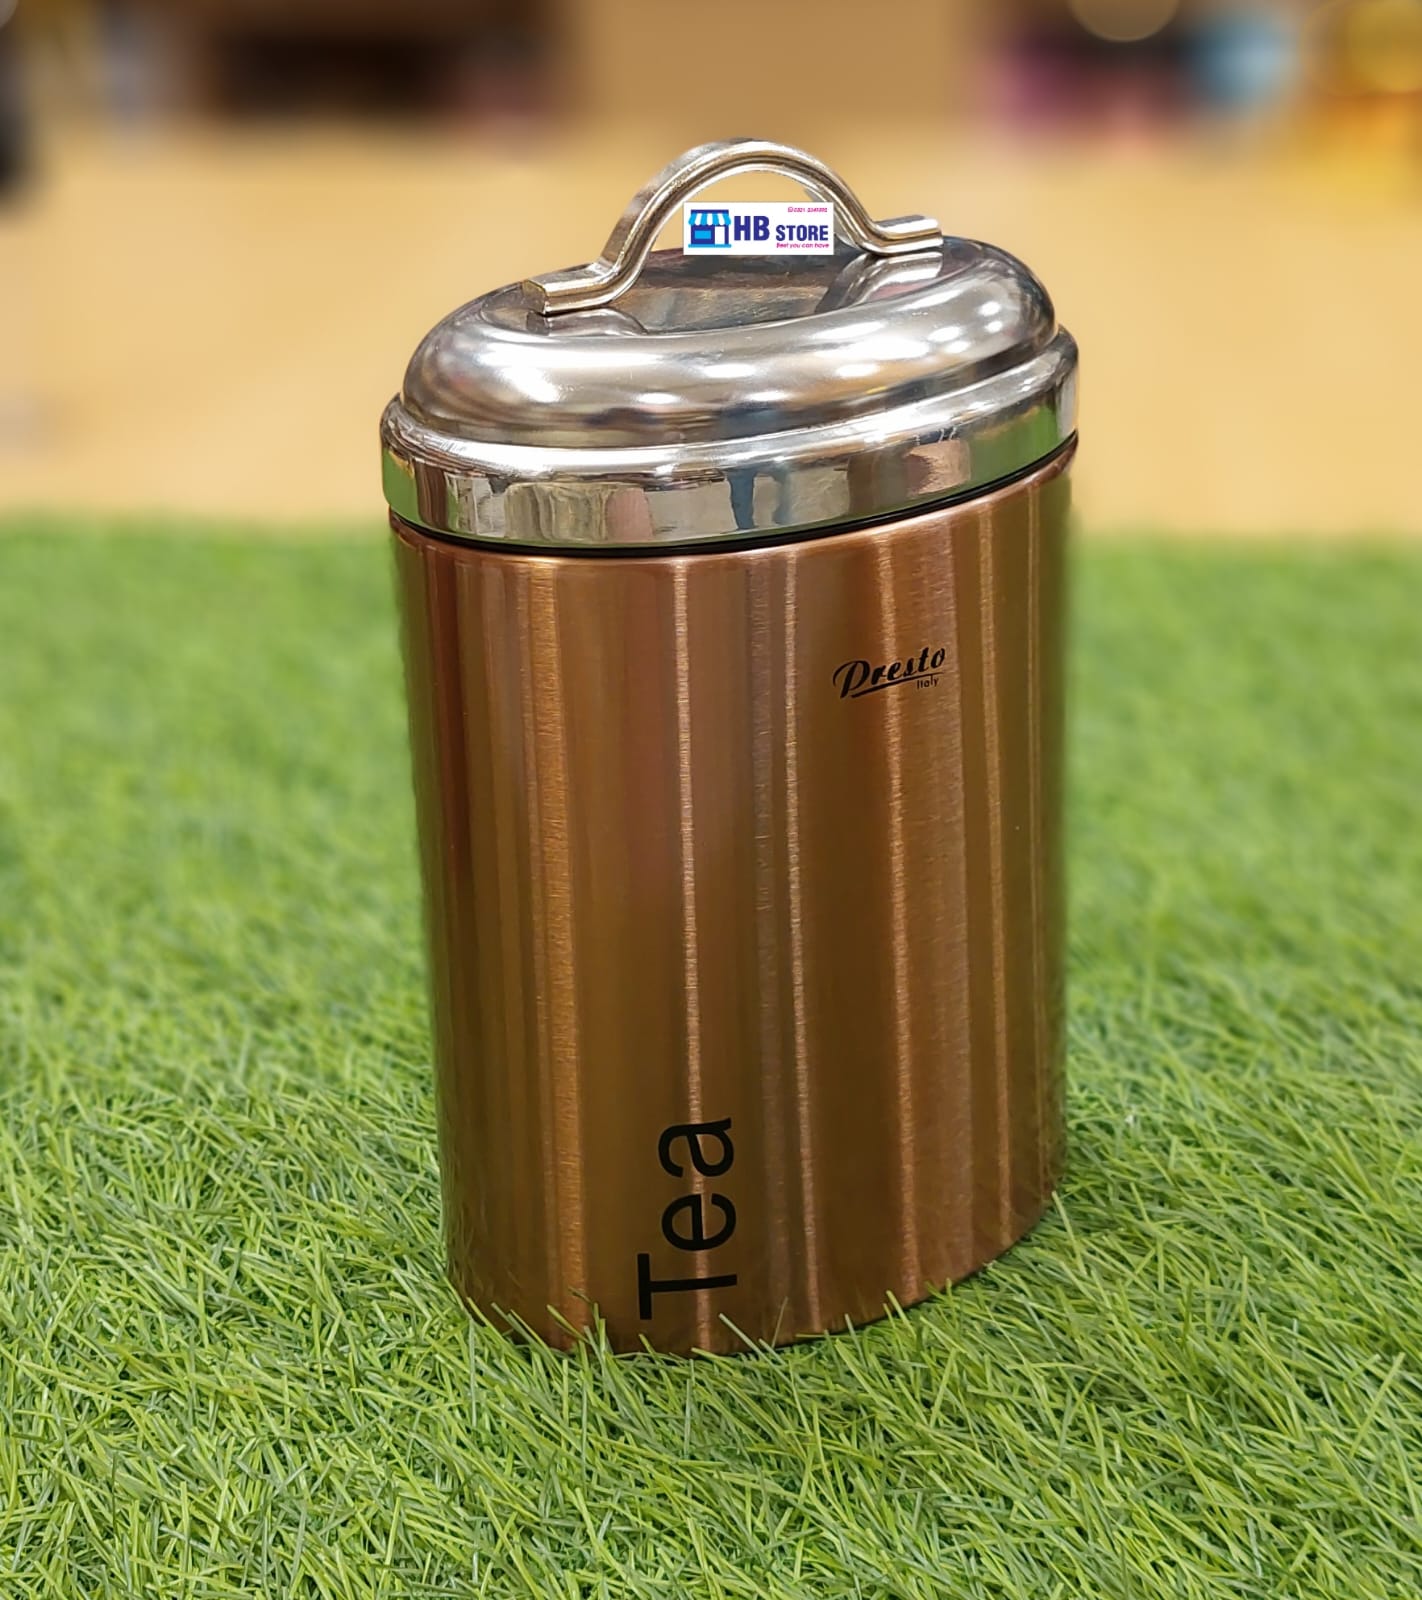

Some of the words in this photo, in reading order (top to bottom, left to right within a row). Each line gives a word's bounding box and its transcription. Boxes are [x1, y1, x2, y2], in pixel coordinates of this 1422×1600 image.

[833, 647, 946, 698] Presto
[916, 675, 939, 690] Italy
[637, 1117, 738, 1320] Tea
